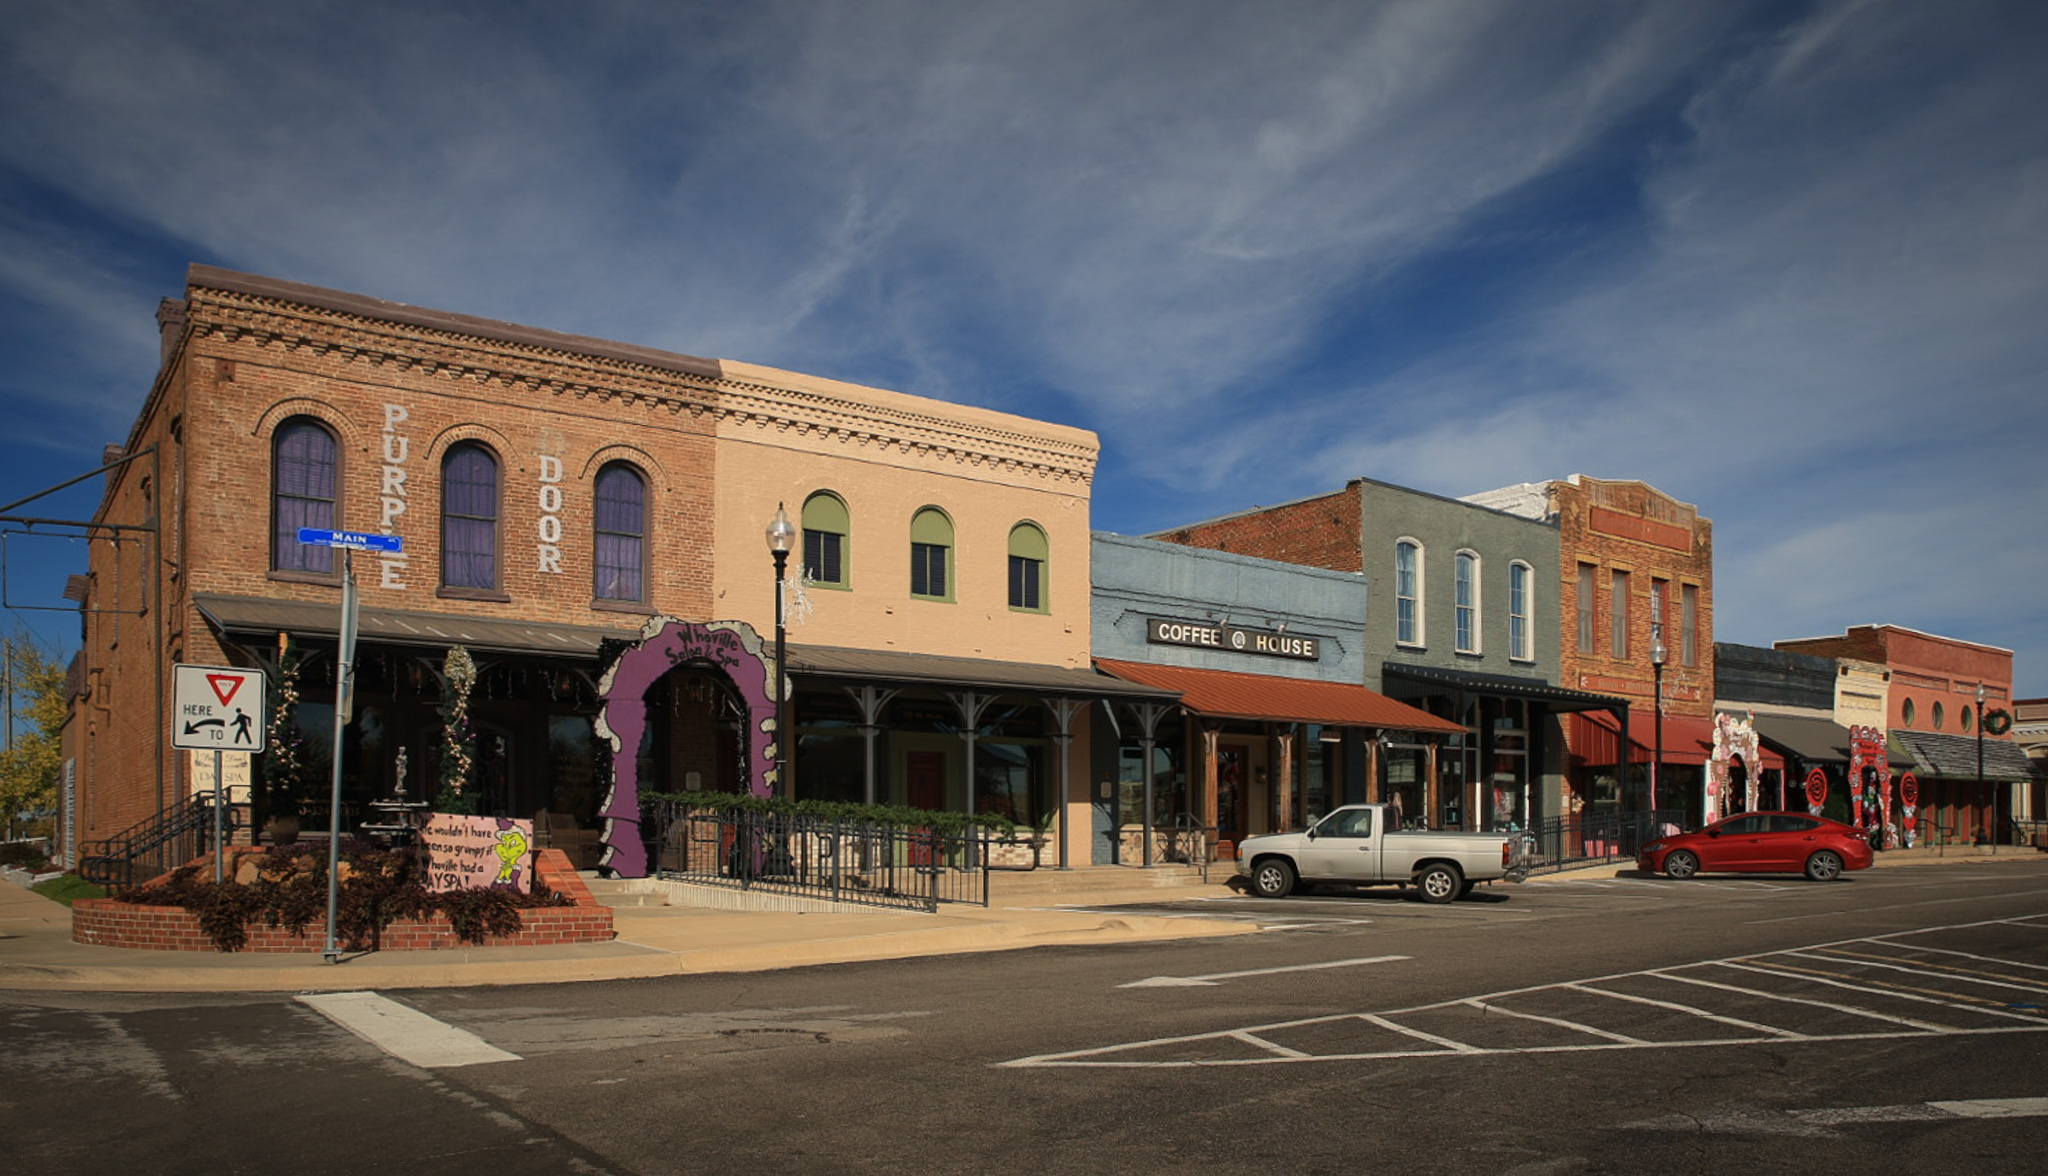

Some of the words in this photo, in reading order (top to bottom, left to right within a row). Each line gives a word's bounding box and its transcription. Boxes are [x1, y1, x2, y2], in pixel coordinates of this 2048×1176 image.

[380, 404, 409, 589] PURPE
[537, 455, 563, 574] DOOR
[677, 626, 738, 651] Whoville
[1158, 623, 1221, 645] COFFEE
[1256, 635, 1313, 656] HOUSE
[665, 646, 702, 665] Salon
[704, 644, 713, 657] &
[716, 647, 740, 667] Spa
[183, 704, 213, 716] HERE
[209, 729, 224, 741] TO
[471, 826, 492, 838] have
[443, 844, 453, 853] so
[455, 845, 485, 859] grumpy
[460, 859, 477, 873] had
[477, 864, 484, 873] a
